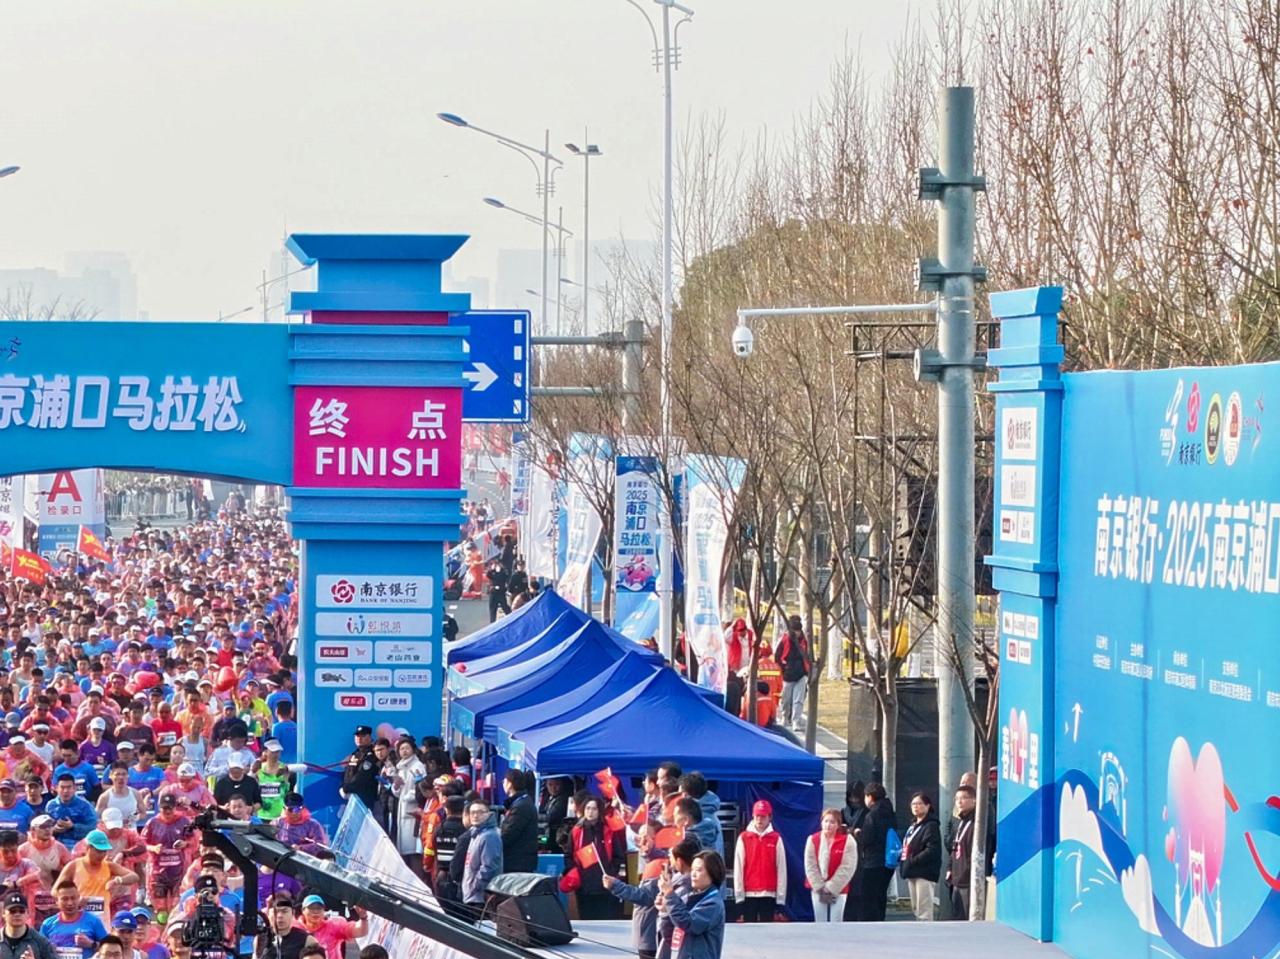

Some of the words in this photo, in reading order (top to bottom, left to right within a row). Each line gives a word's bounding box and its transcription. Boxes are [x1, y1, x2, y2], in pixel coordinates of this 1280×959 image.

[315, 447, 438, 476] FINISH
[360, 582, 418, 598] 南京银行
